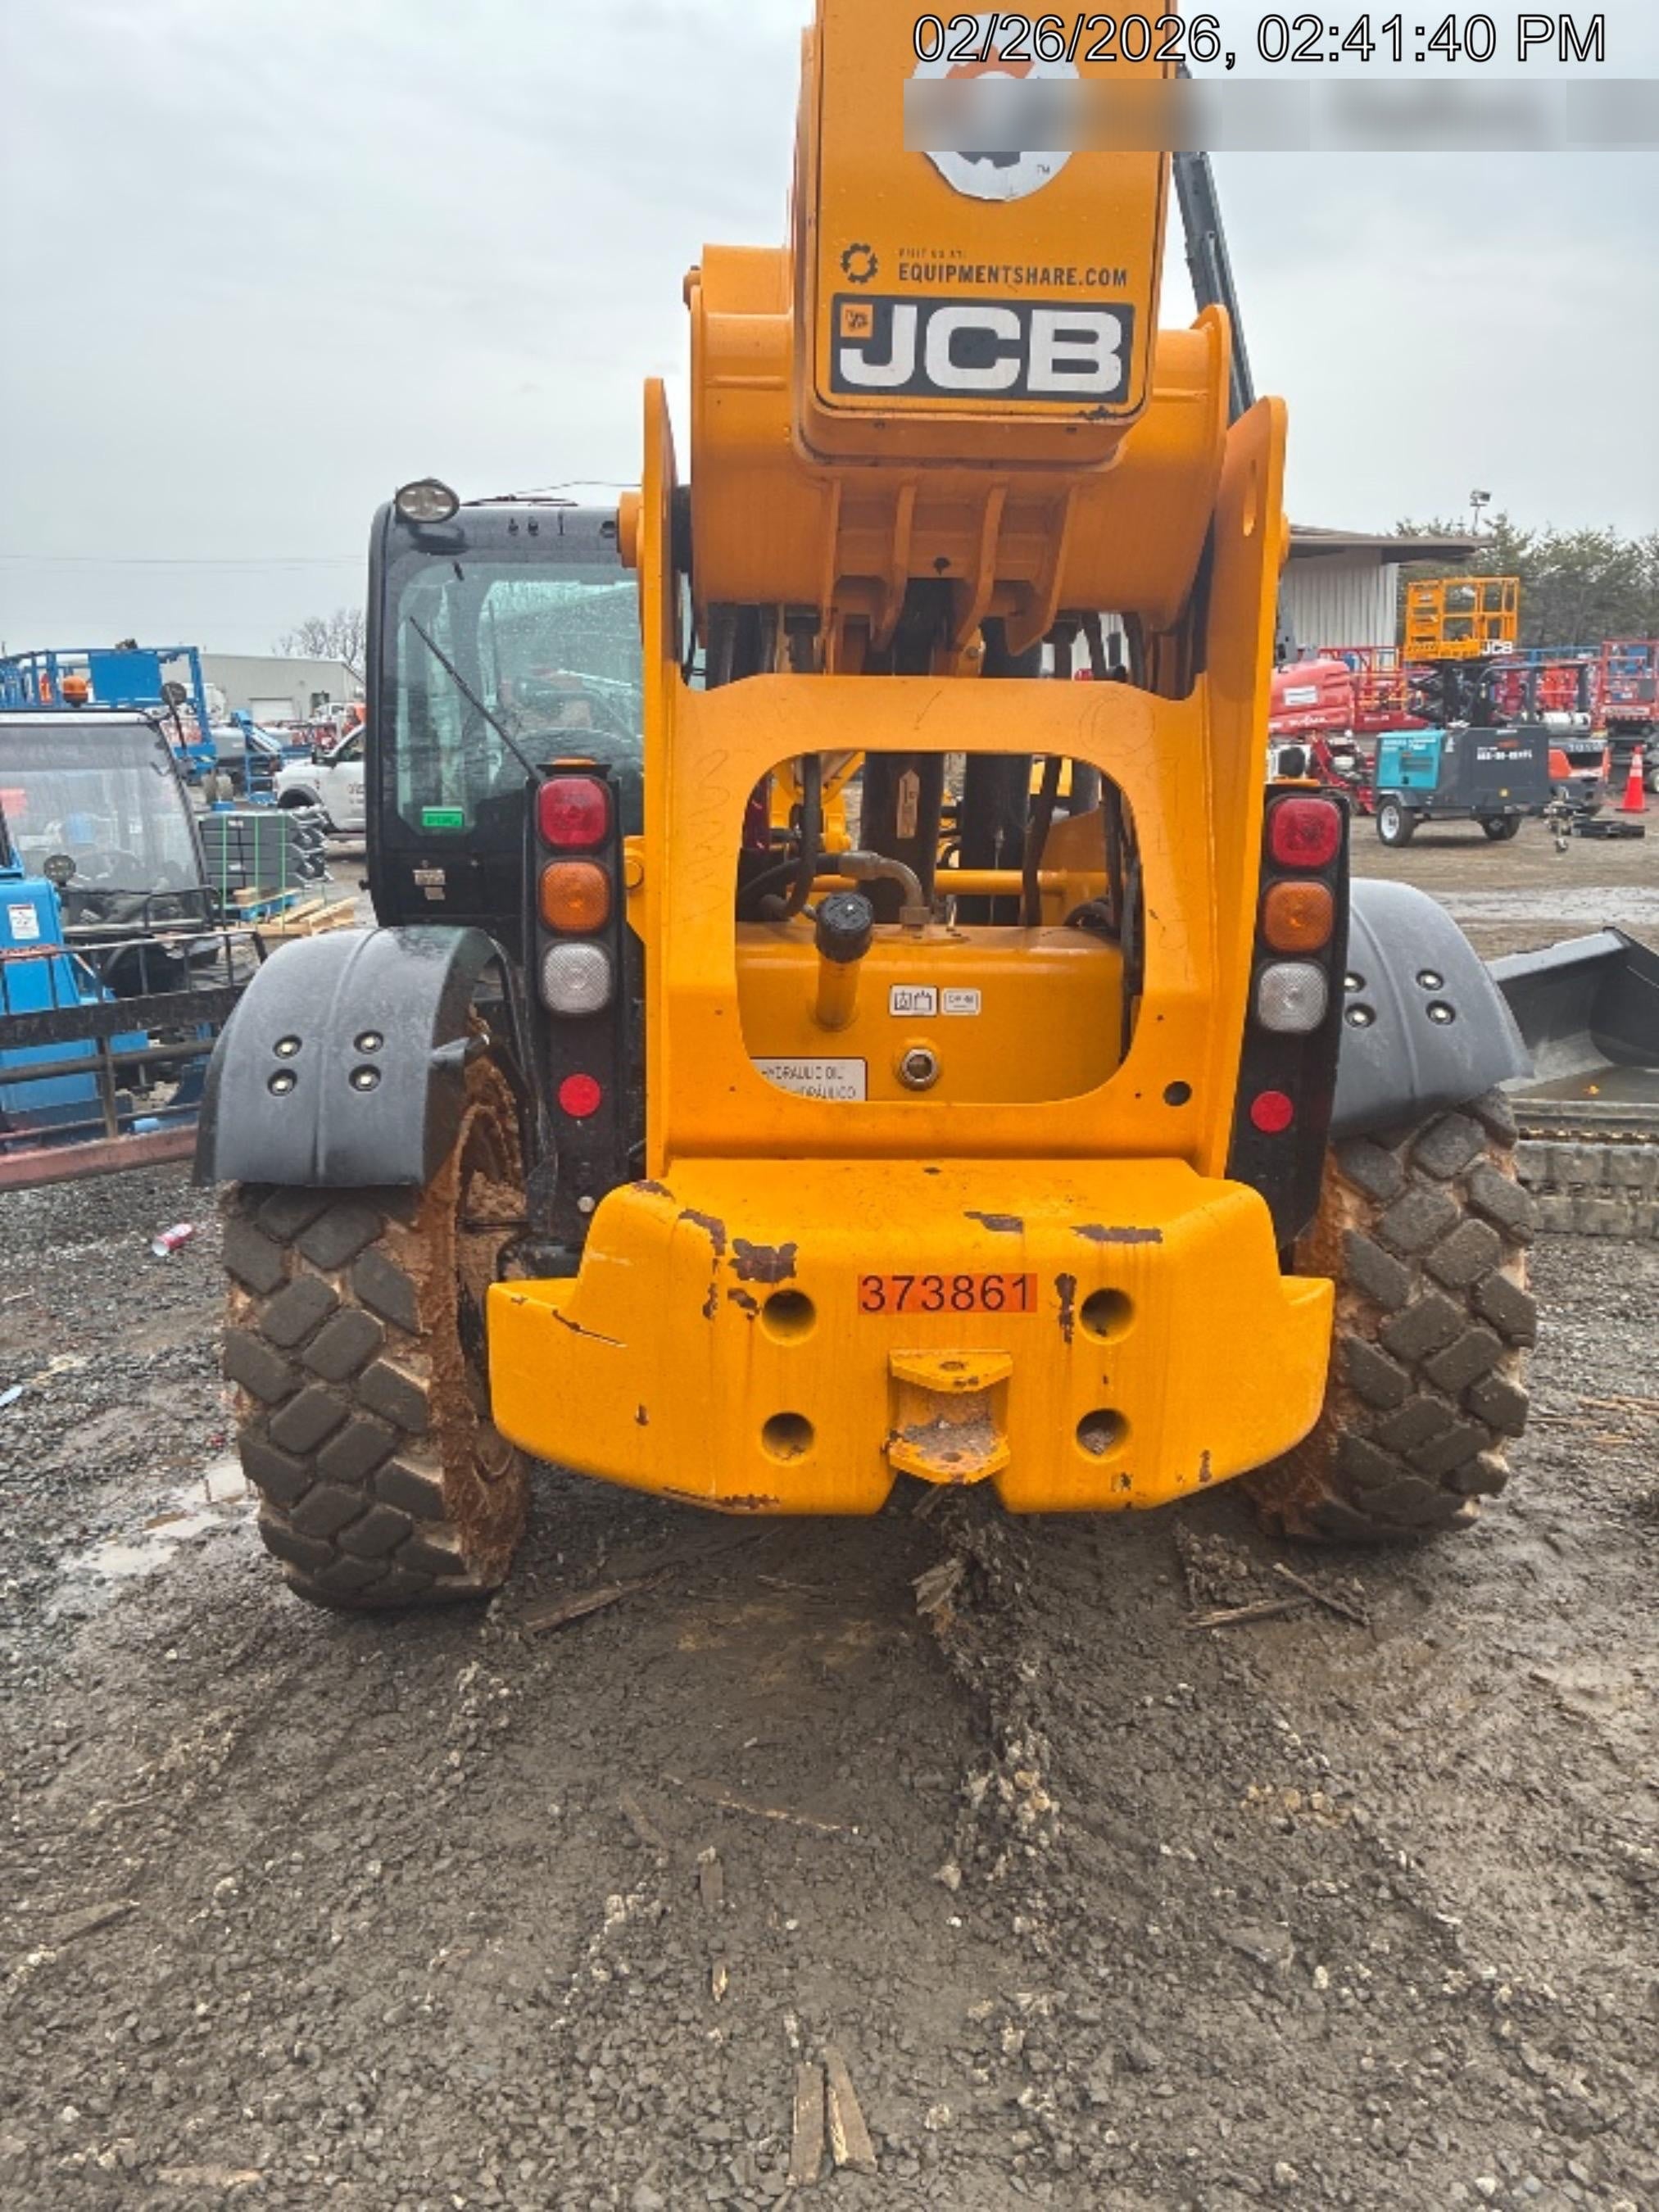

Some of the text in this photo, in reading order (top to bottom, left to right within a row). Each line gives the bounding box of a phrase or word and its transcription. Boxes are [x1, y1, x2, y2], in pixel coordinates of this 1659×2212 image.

[899, 262, 1127, 286] EQUIPMENTSHARE.COM
[840, 304, 1122, 392] JCB
[862, 1274, 1028, 1312] 373861
